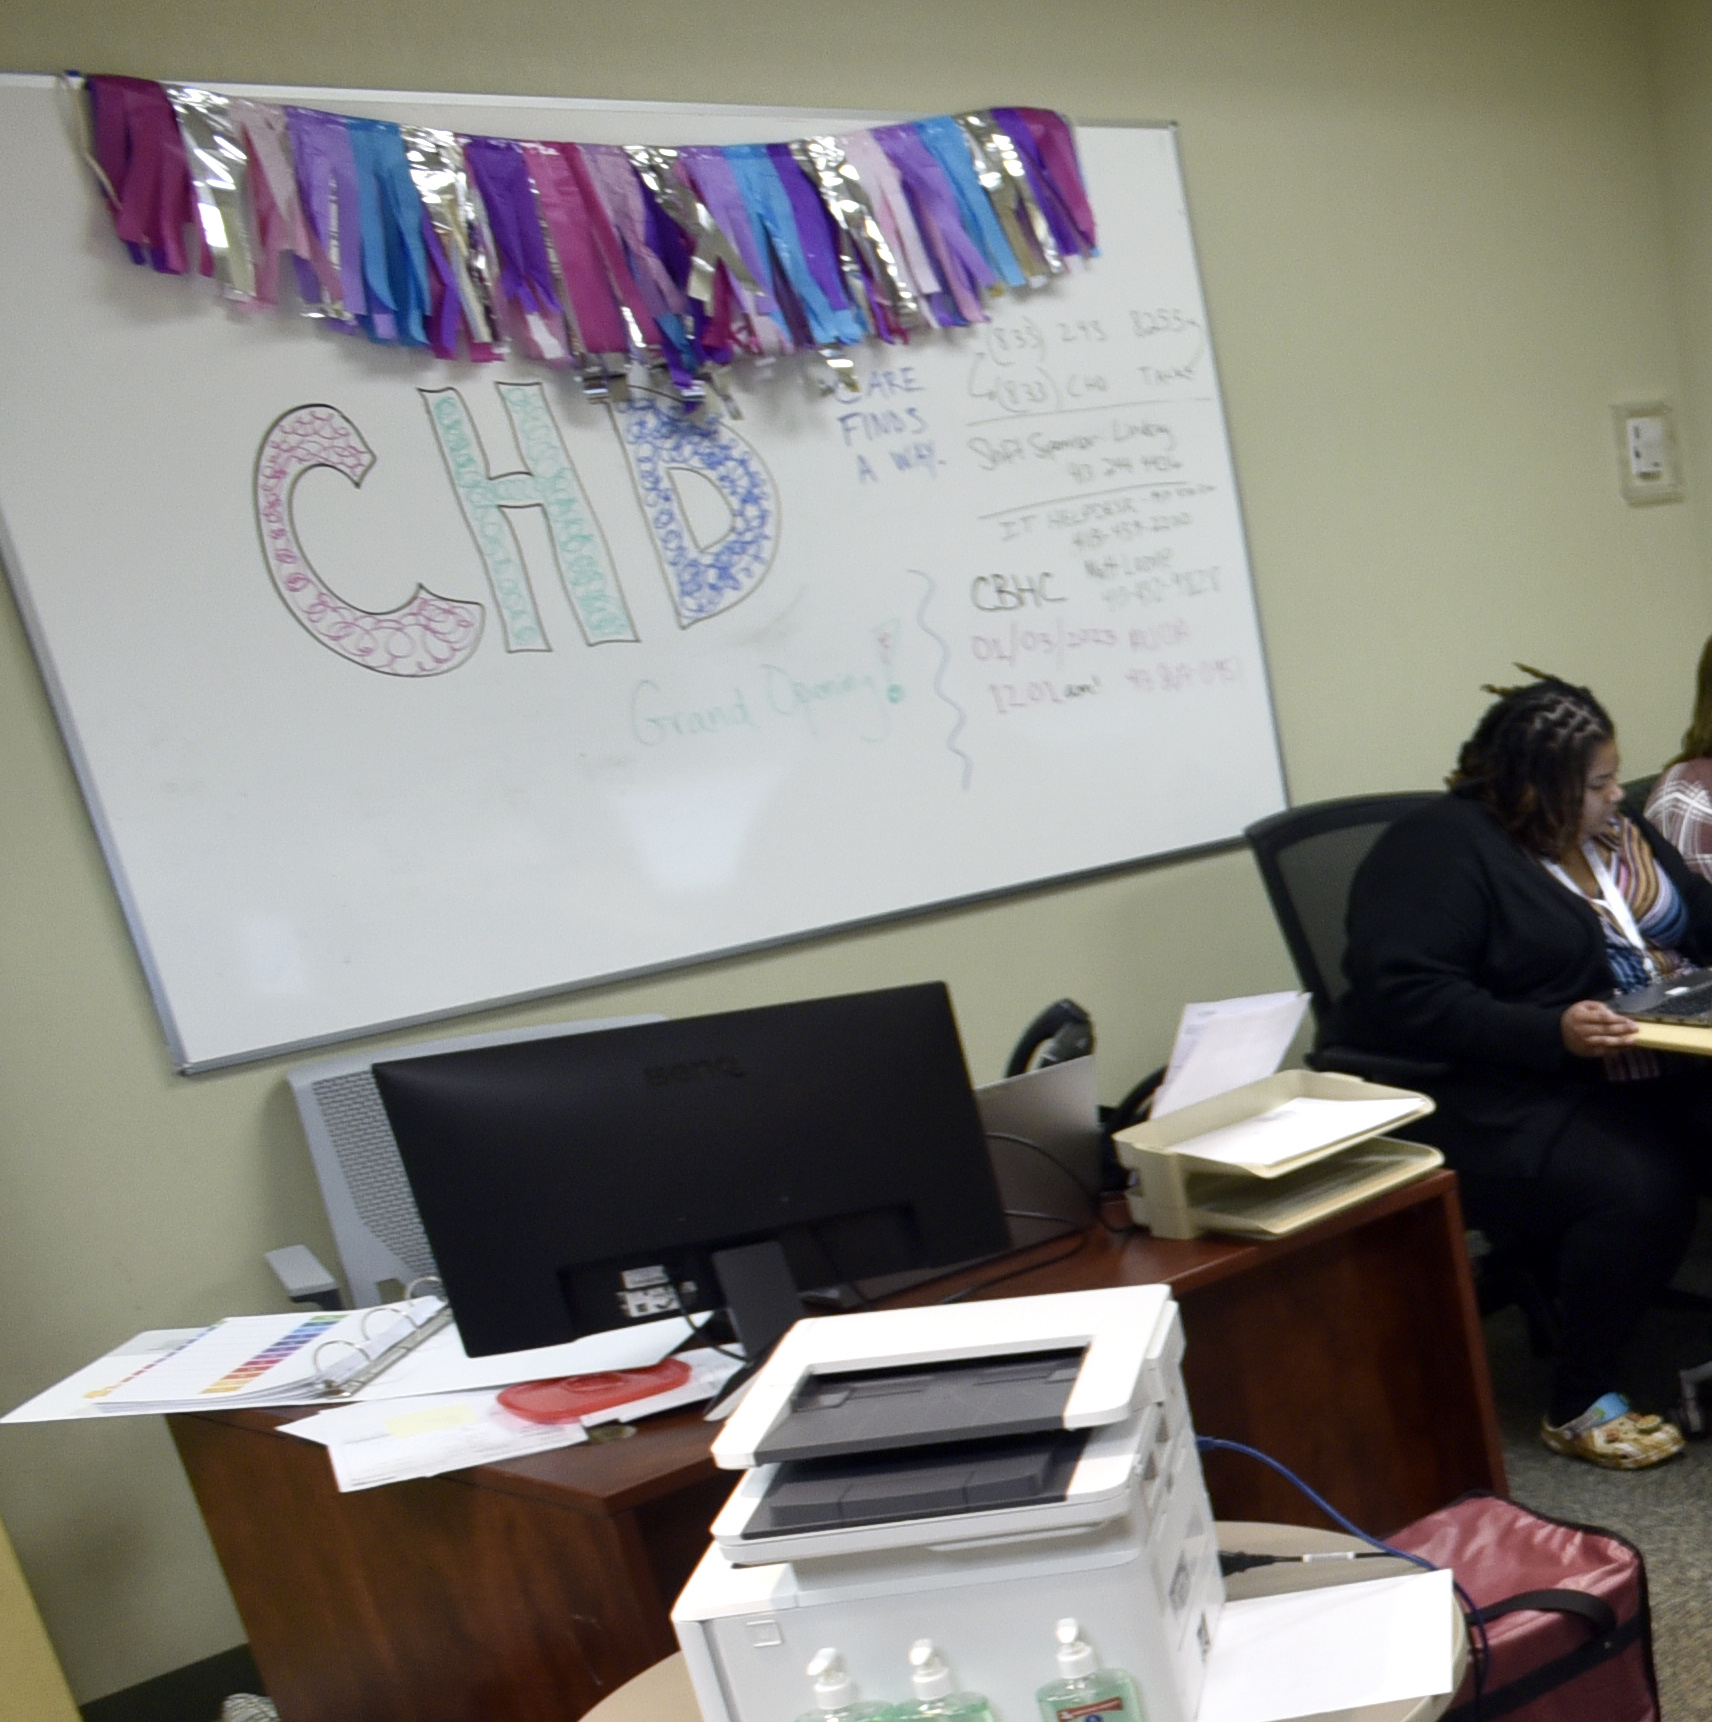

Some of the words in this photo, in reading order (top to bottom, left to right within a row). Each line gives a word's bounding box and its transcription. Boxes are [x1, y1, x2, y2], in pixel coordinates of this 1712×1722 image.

[253, 380, 783, 679] CHD
[970, 570, 1069, 613] CBHC
[630, 678, 760, 747] Grand
